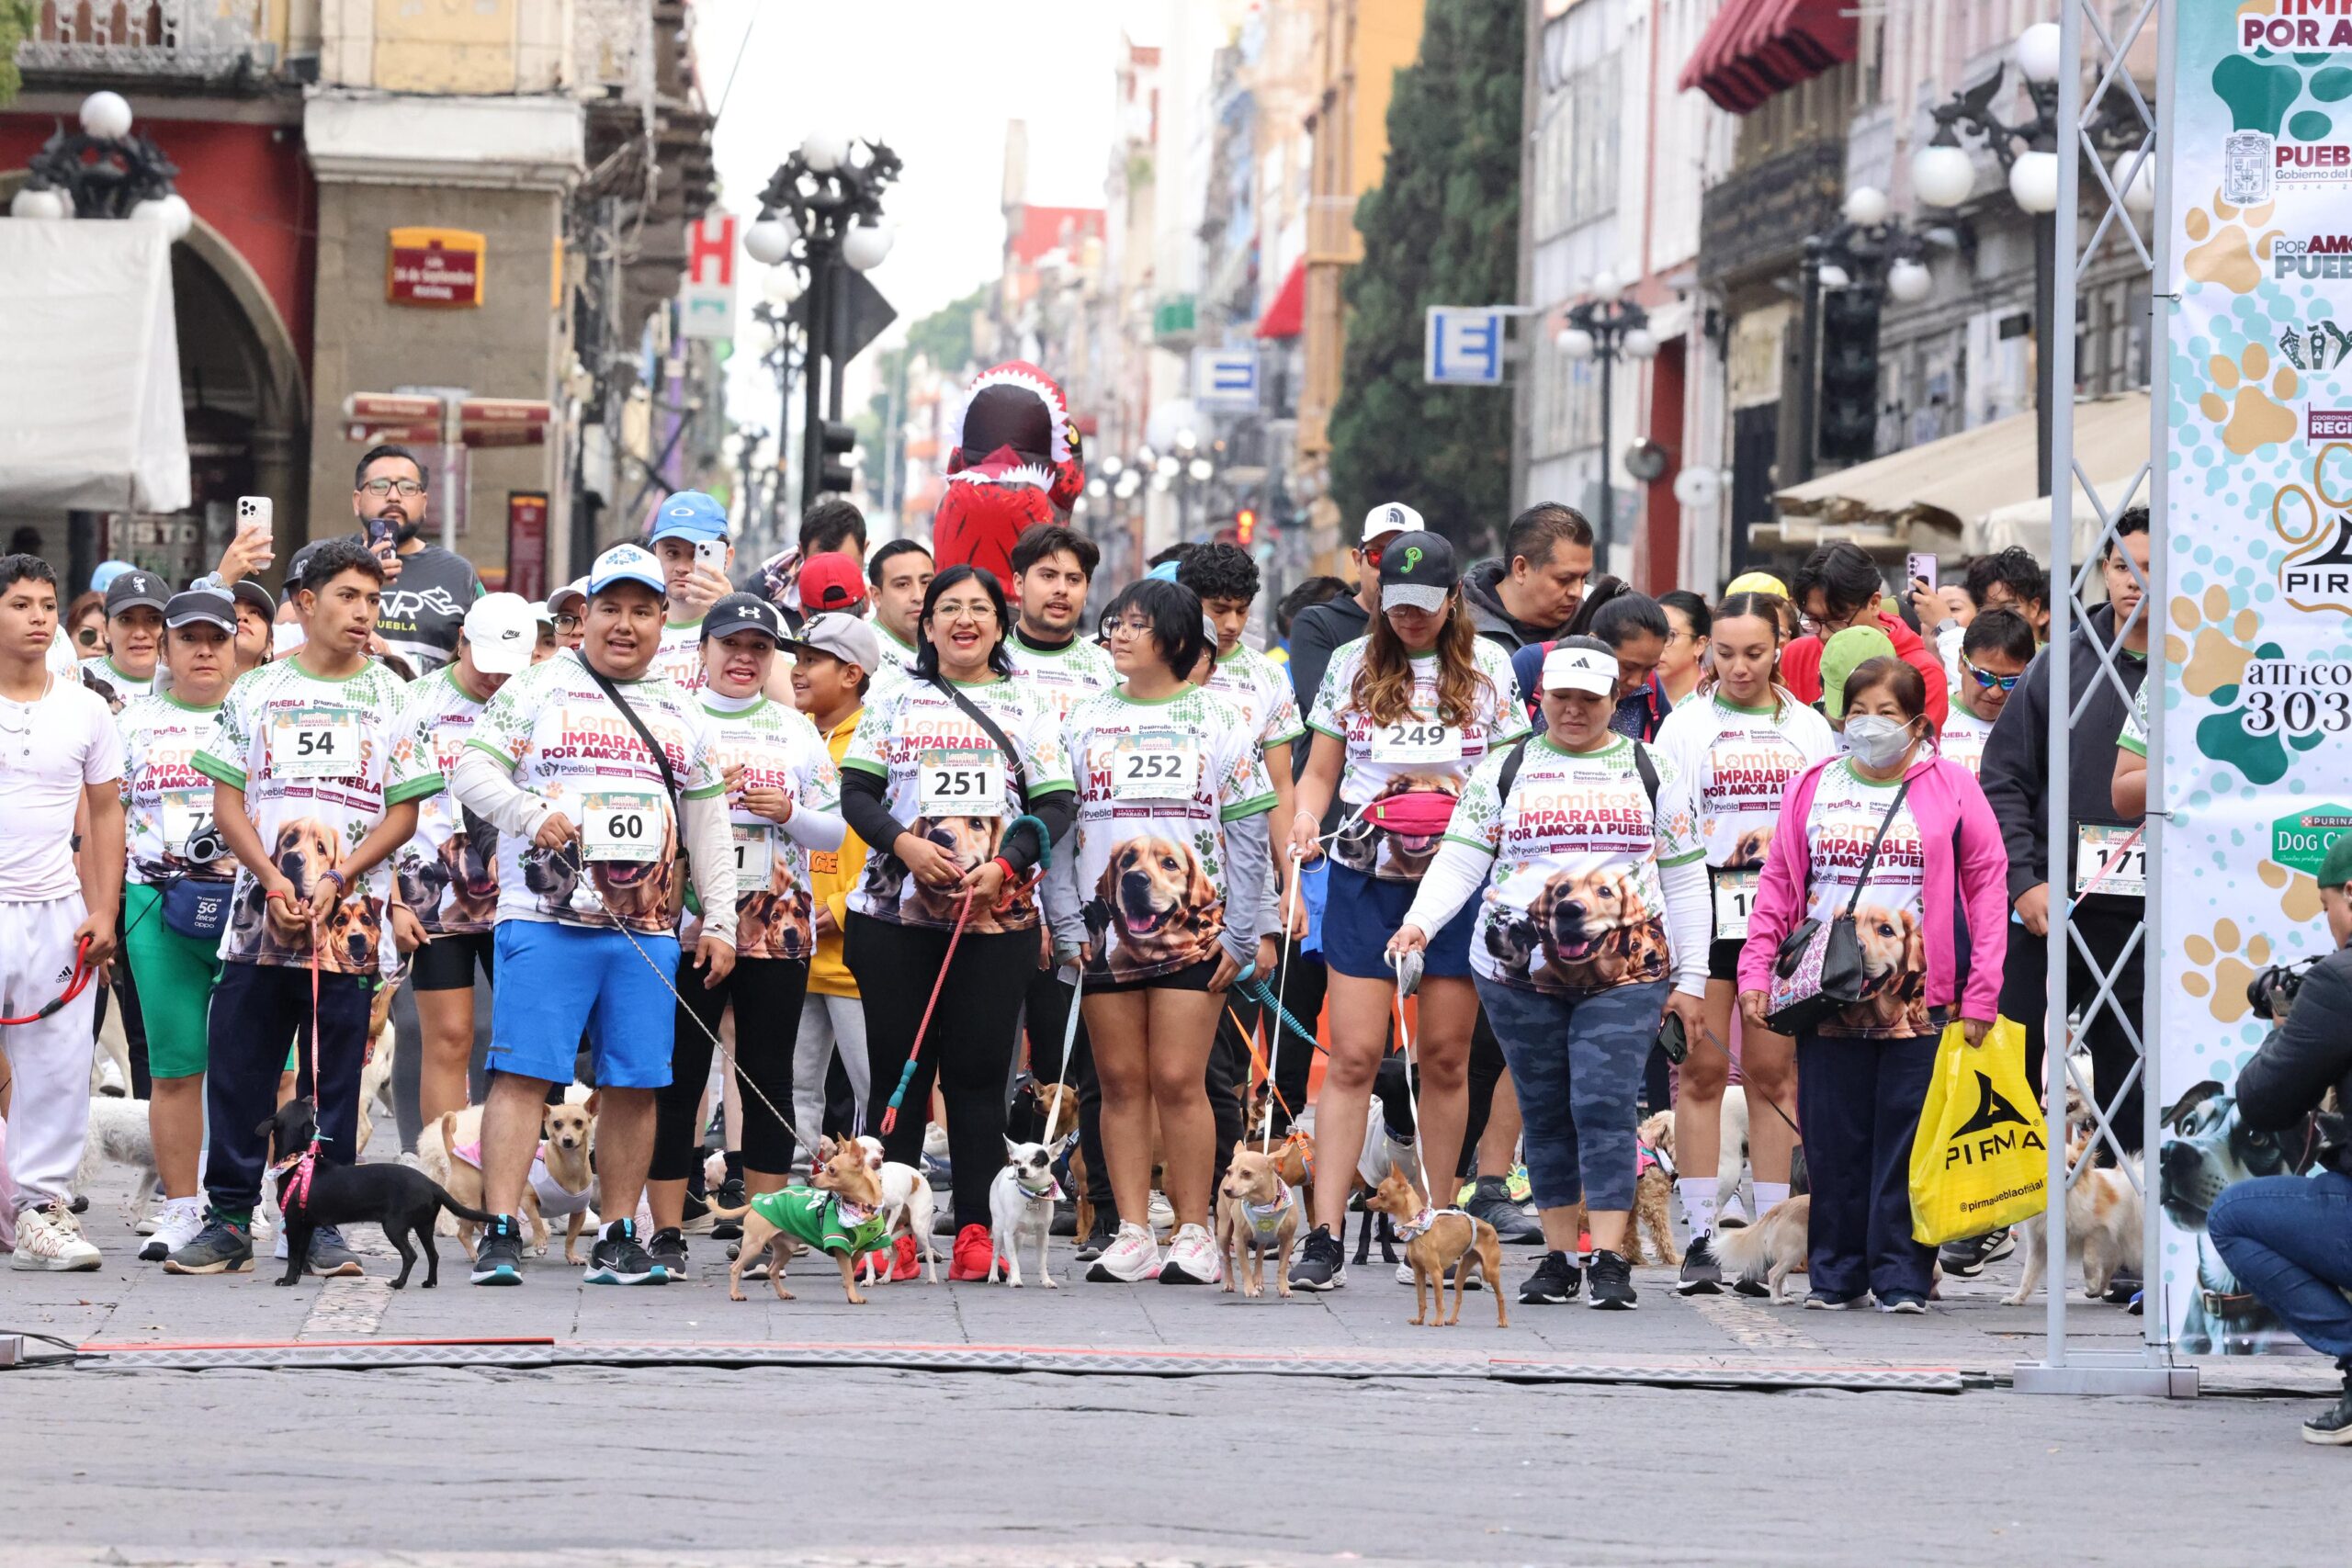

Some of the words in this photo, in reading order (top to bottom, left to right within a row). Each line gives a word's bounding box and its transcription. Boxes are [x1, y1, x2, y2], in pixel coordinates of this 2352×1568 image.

[2245, 18, 2320, 47] POR
[2276, 146, 2351, 167] PUEB
[2276, 169, 2328, 180] Gobierno
[2331, 168, 2348, 178] del
[2275, 255, 2352, 279] PUEB
[2312, 422, 2352, 434] REGI
[2288, 573, 2349, 592] PIR
[378, 620, 417, 632] UEBLA
[568, 691, 605, 700] PUEBLA
[441, 715, 474, 723] PUEBLA
[2246, 691, 2352, 732] 303
[561, 709, 684, 746] Lomos
[1095, 726, 1130, 734] PUEBLA
[1389, 726, 1446, 746] 249
[1719, 730, 1745, 739] UEBLA
[297, 731, 335, 755] 54
[561, 732, 685, 761] IMPARAES
[542, 746, 577, 761] POR
[582, 746, 633, 762] AMOR
[635, 751, 647, 763] A
[1126, 755, 1182, 779] 252
[1526, 772, 1566, 780] PUEBLA
[159, 776, 209, 790] AMOR
[934, 771, 986, 795] 251
[1703, 784, 1726, 798] POR
[1729, 784, 1768, 796] AMOR
[1519, 789, 1642, 813] Lomitos
[1827, 798, 1862, 809] PUEBLA
[608, 814, 642, 839] 60
[1519, 807, 1643, 828] IMPARABLES
[2313, 818, 2352, 826] PURINA
[1509, 828, 1532, 842] POR
[1535, 823, 1589, 838] AMOR
[1591, 823, 1603, 835] A
[1606, 823, 1651, 837] PUEBLA
[2278, 831, 2318, 852] DOG
[1816, 838, 1924, 857] IMPARBLE
[1829, 854, 1865, 869] AMO
[196, 914, 218, 922] telcel
[198, 903, 218, 915] 5G
[194, 921, 215, 930] oppo
